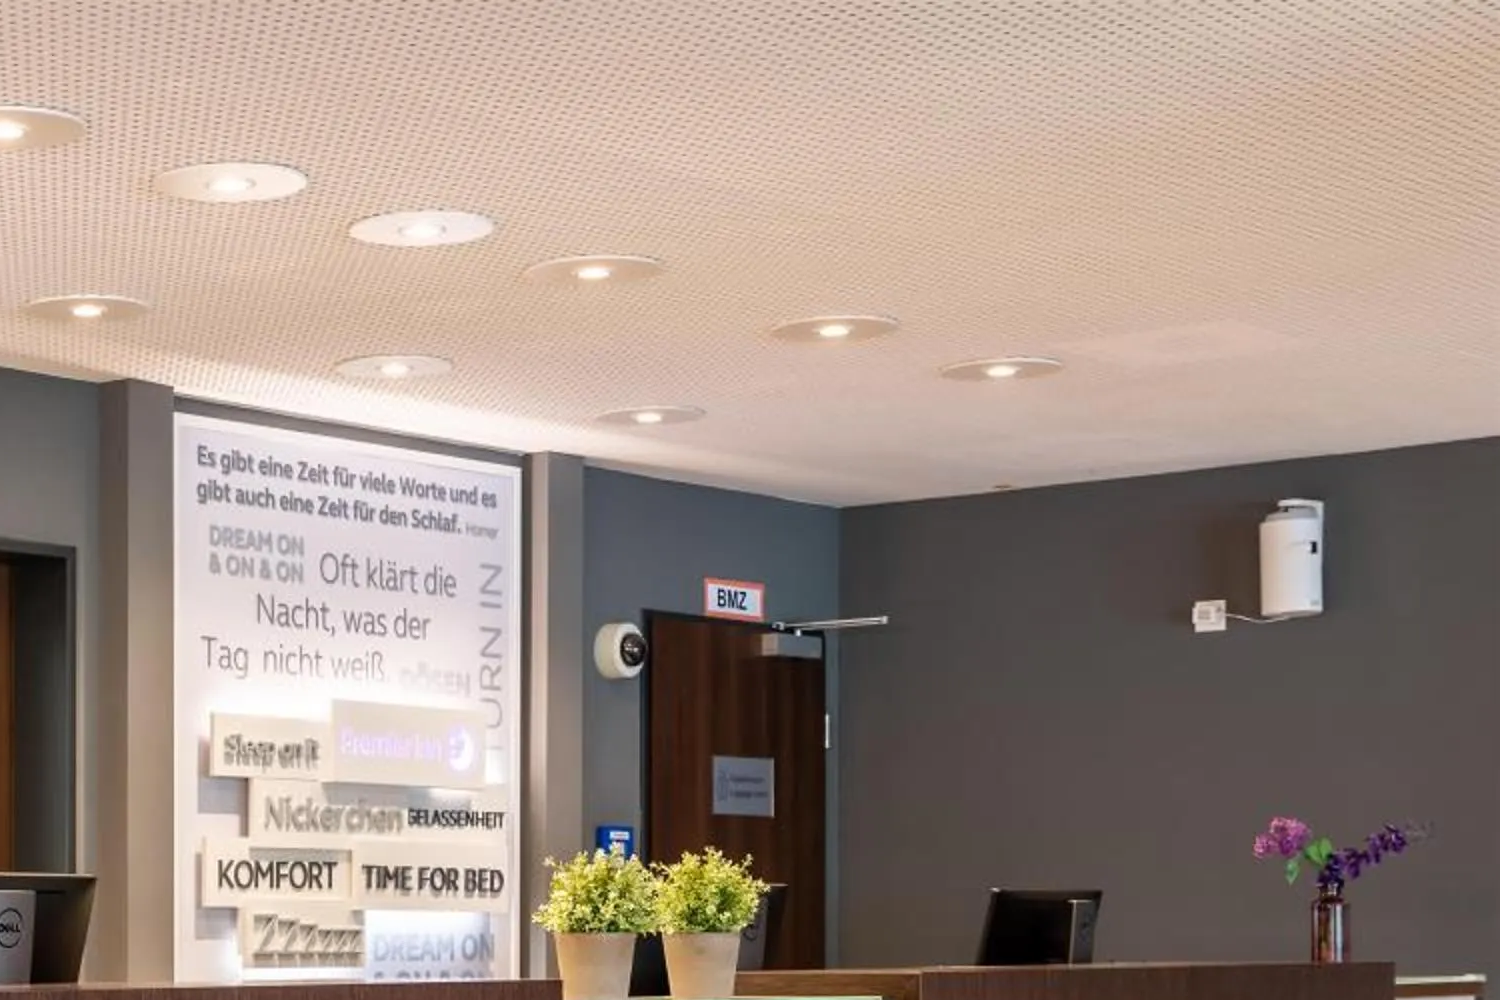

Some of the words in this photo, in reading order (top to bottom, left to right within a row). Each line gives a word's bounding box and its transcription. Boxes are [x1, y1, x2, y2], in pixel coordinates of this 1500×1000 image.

[197, 444, 216, 468] Es
[220, 448, 254, 475] gibt
[258, 456, 293, 480] eine
[297, 461, 329, 486] Zeit
[333, 466, 356, 489] für
[360, 471, 396, 495] viele
[400, 475, 447, 501] Worte
[450, 486, 478, 506] und
[481, 492, 497, 509] es
[196, 480, 231, 505] gibt
[235, 487, 275, 510] auch
[280, 491, 315, 515] eine
[318, 496, 350, 520] Zeit
[353, 500, 376, 522] für
[379, 504, 408, 528] den
[412, 509, 462, 535] Schlaf.
[209, 524, 273, 553] DREAM
[277, 534, 305, 557] ON
[226, 554, 254, 578] ON
[276, 559, 304, 583] ON
[319, 552, 360, 588] Oft
[366, 557, 419, 595] klärt
[424, 564, 457, 598] die
[717, 588, 748, 610] BMZ
[257, 592, 335, 637] Nacht,
[343, 609, 387, 638] was
[394, 608, 431, 640] der
[200, 635, 248, 680] Tag
[263, 643, 323, 678] nicht
[264, 796, 403, 834] Nickerchen
[408, 808, 505, 829] GELASSENHEIT
[218, 860, 338, 890] KOMFORT
[362, 864, 413, 891] TIME
[418, 866, 459, 892] FOR
[464, 868, 504, 893] BED
[373, 934, 454, 961] DREAM
[461, 933, 495, 962] ON
